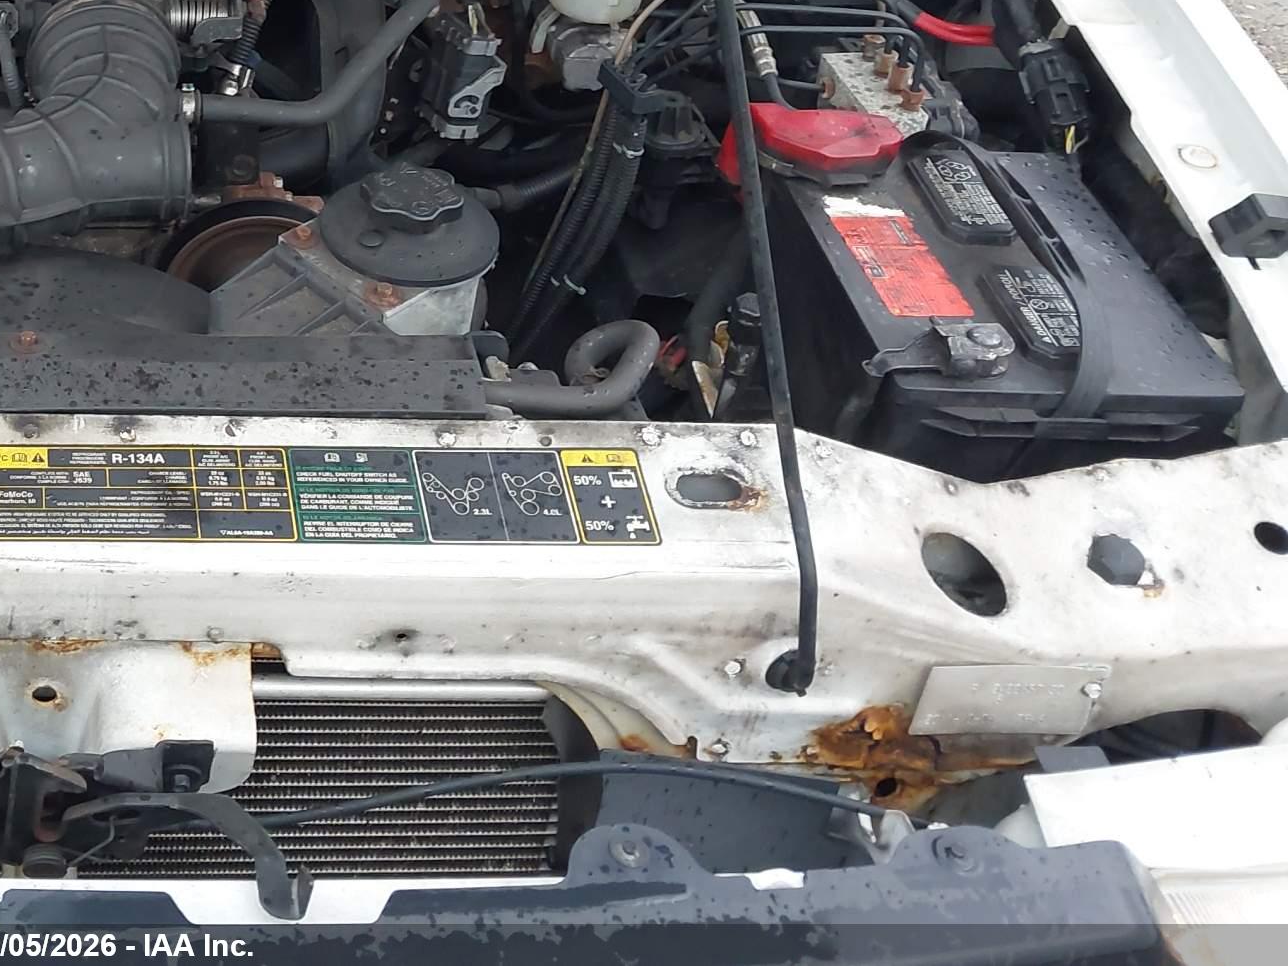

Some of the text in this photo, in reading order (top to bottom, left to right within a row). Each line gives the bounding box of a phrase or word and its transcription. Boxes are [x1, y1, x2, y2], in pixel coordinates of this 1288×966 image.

[112, 453, 165, 464] R-134A
[573, 475, 602, 486] 50%
[585, 521, 614, 531] 50%
